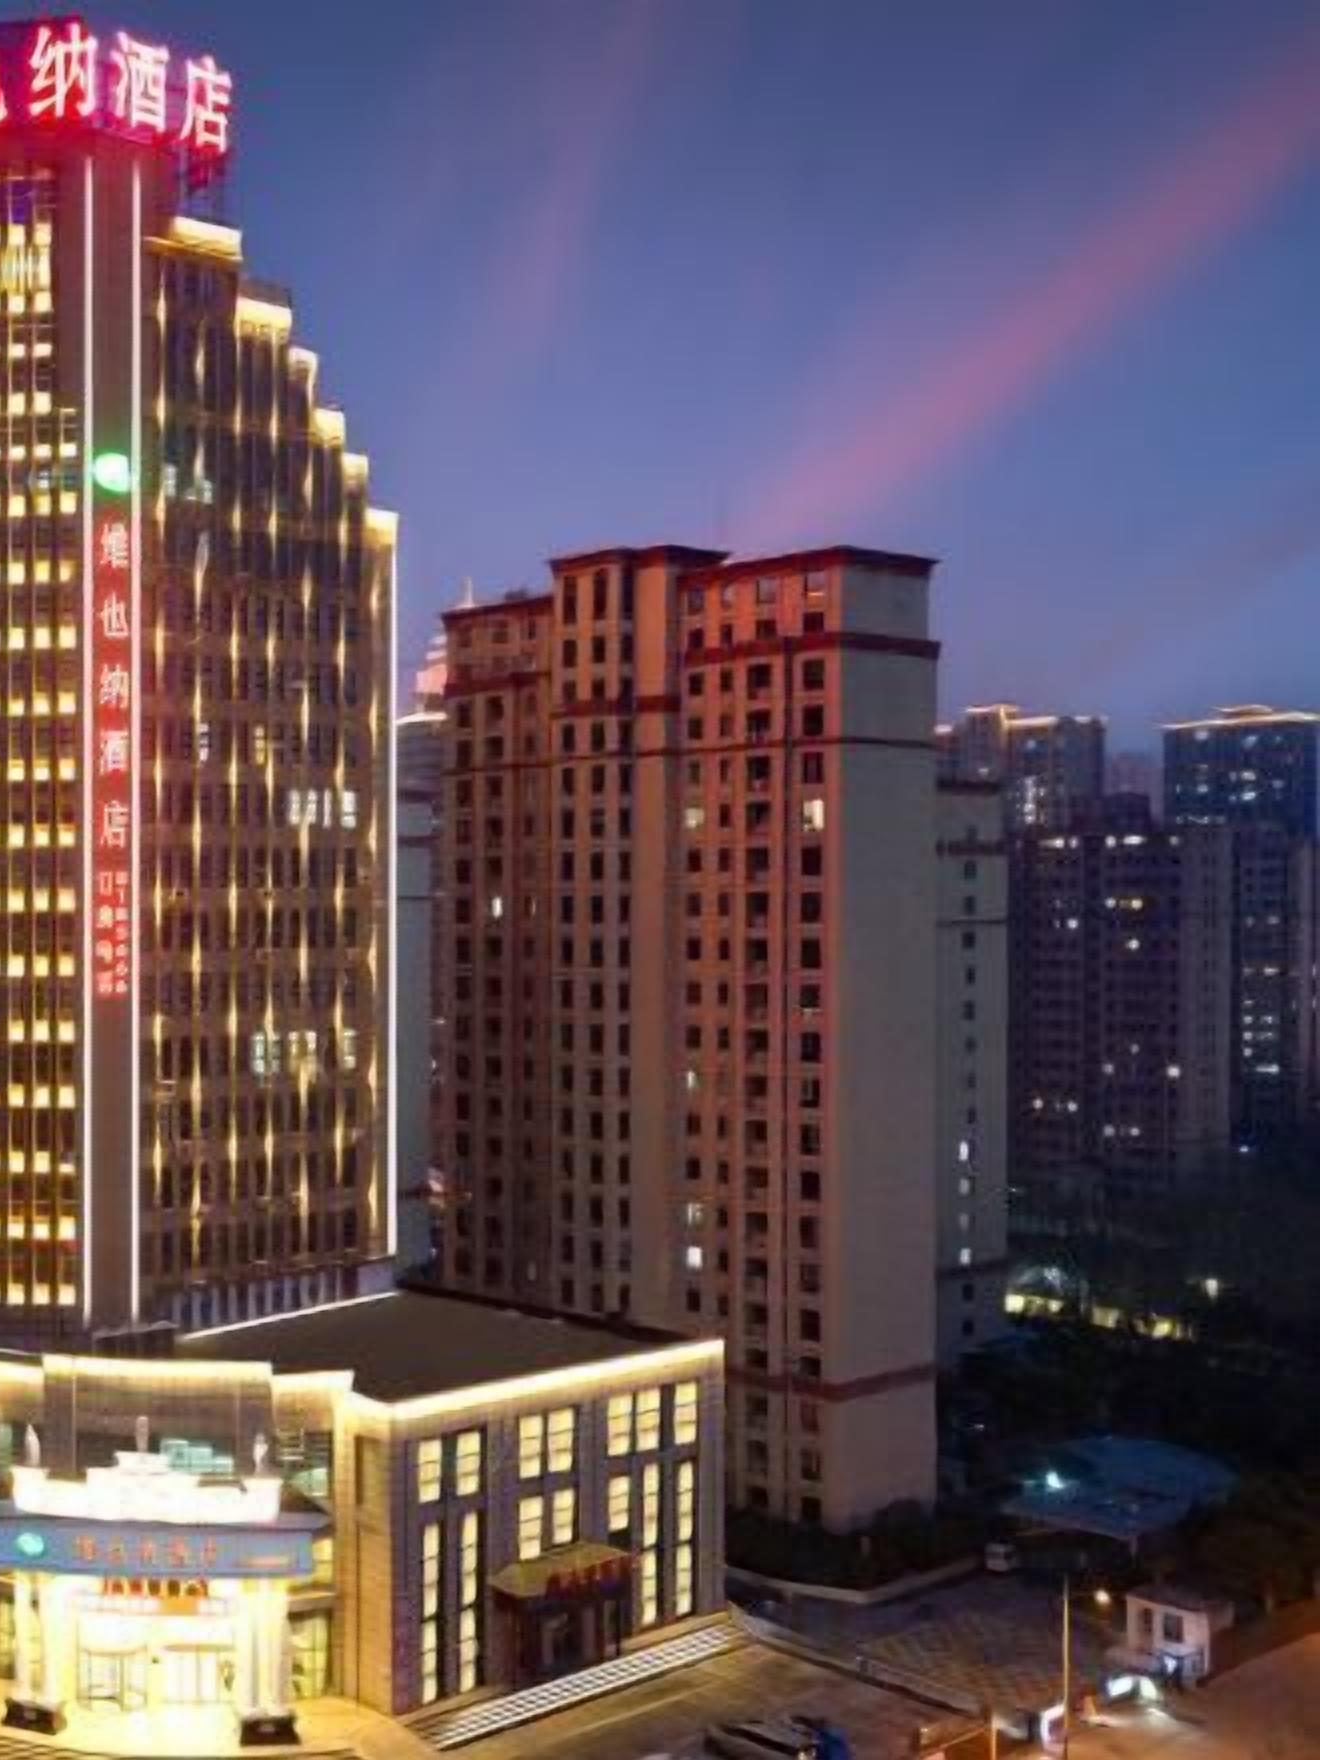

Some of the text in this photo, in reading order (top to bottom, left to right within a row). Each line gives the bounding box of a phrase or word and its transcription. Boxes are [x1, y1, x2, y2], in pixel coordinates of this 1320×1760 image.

[98, 521, 130, 849] 维也纳酒店
